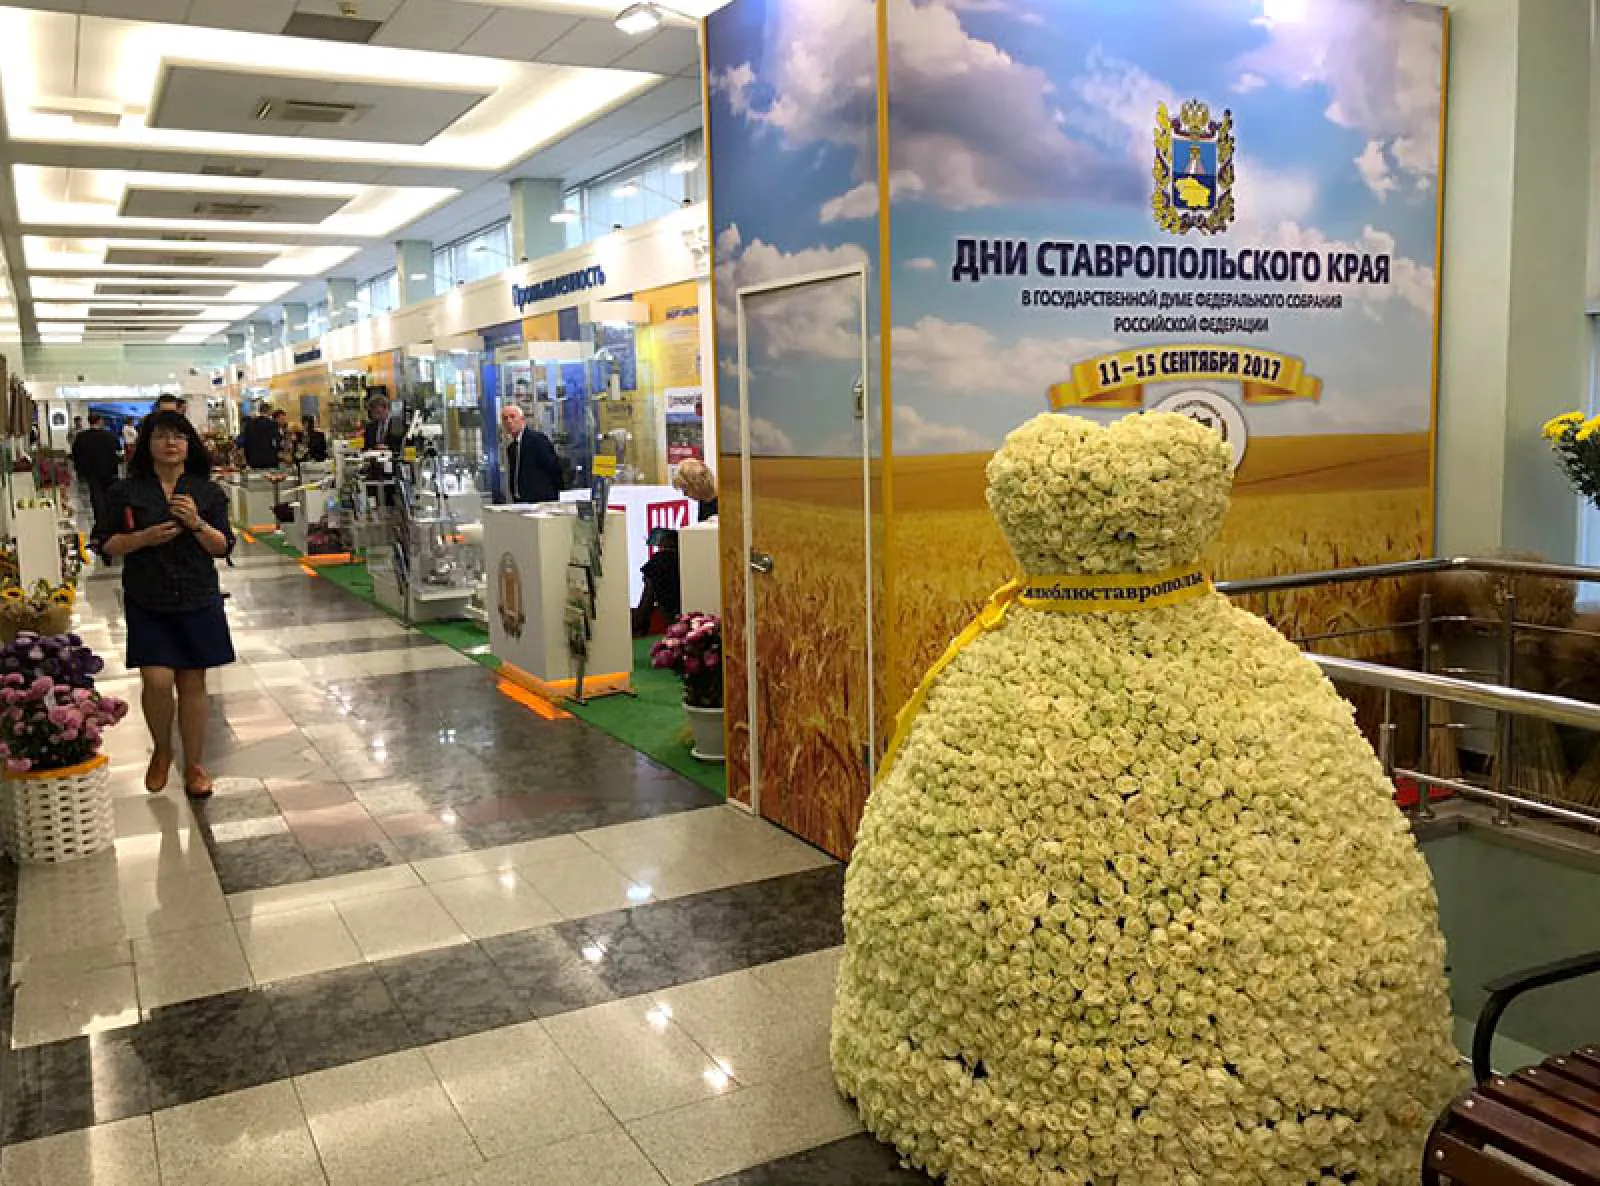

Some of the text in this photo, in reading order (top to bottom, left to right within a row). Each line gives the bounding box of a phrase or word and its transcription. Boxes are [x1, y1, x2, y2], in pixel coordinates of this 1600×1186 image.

[952, 239, 1390, 284] ДНИ СТАВРОПОЛЬСКОГО КРАЯ
[1021, 288, 1343, 310] В ГОСУДАРСТВЕННОЙ ДУМЕ ФЕДЕРАЛЬНОГО СОБРАНИЯ
[1113, 313, 1269, 334] РОССИЙСКОЙ ФЕДЕРАЦИИ
[1161, 351, 1239, 374] СЕНТЯБРЯ
[1242, 353, 1281, 381] 2017
